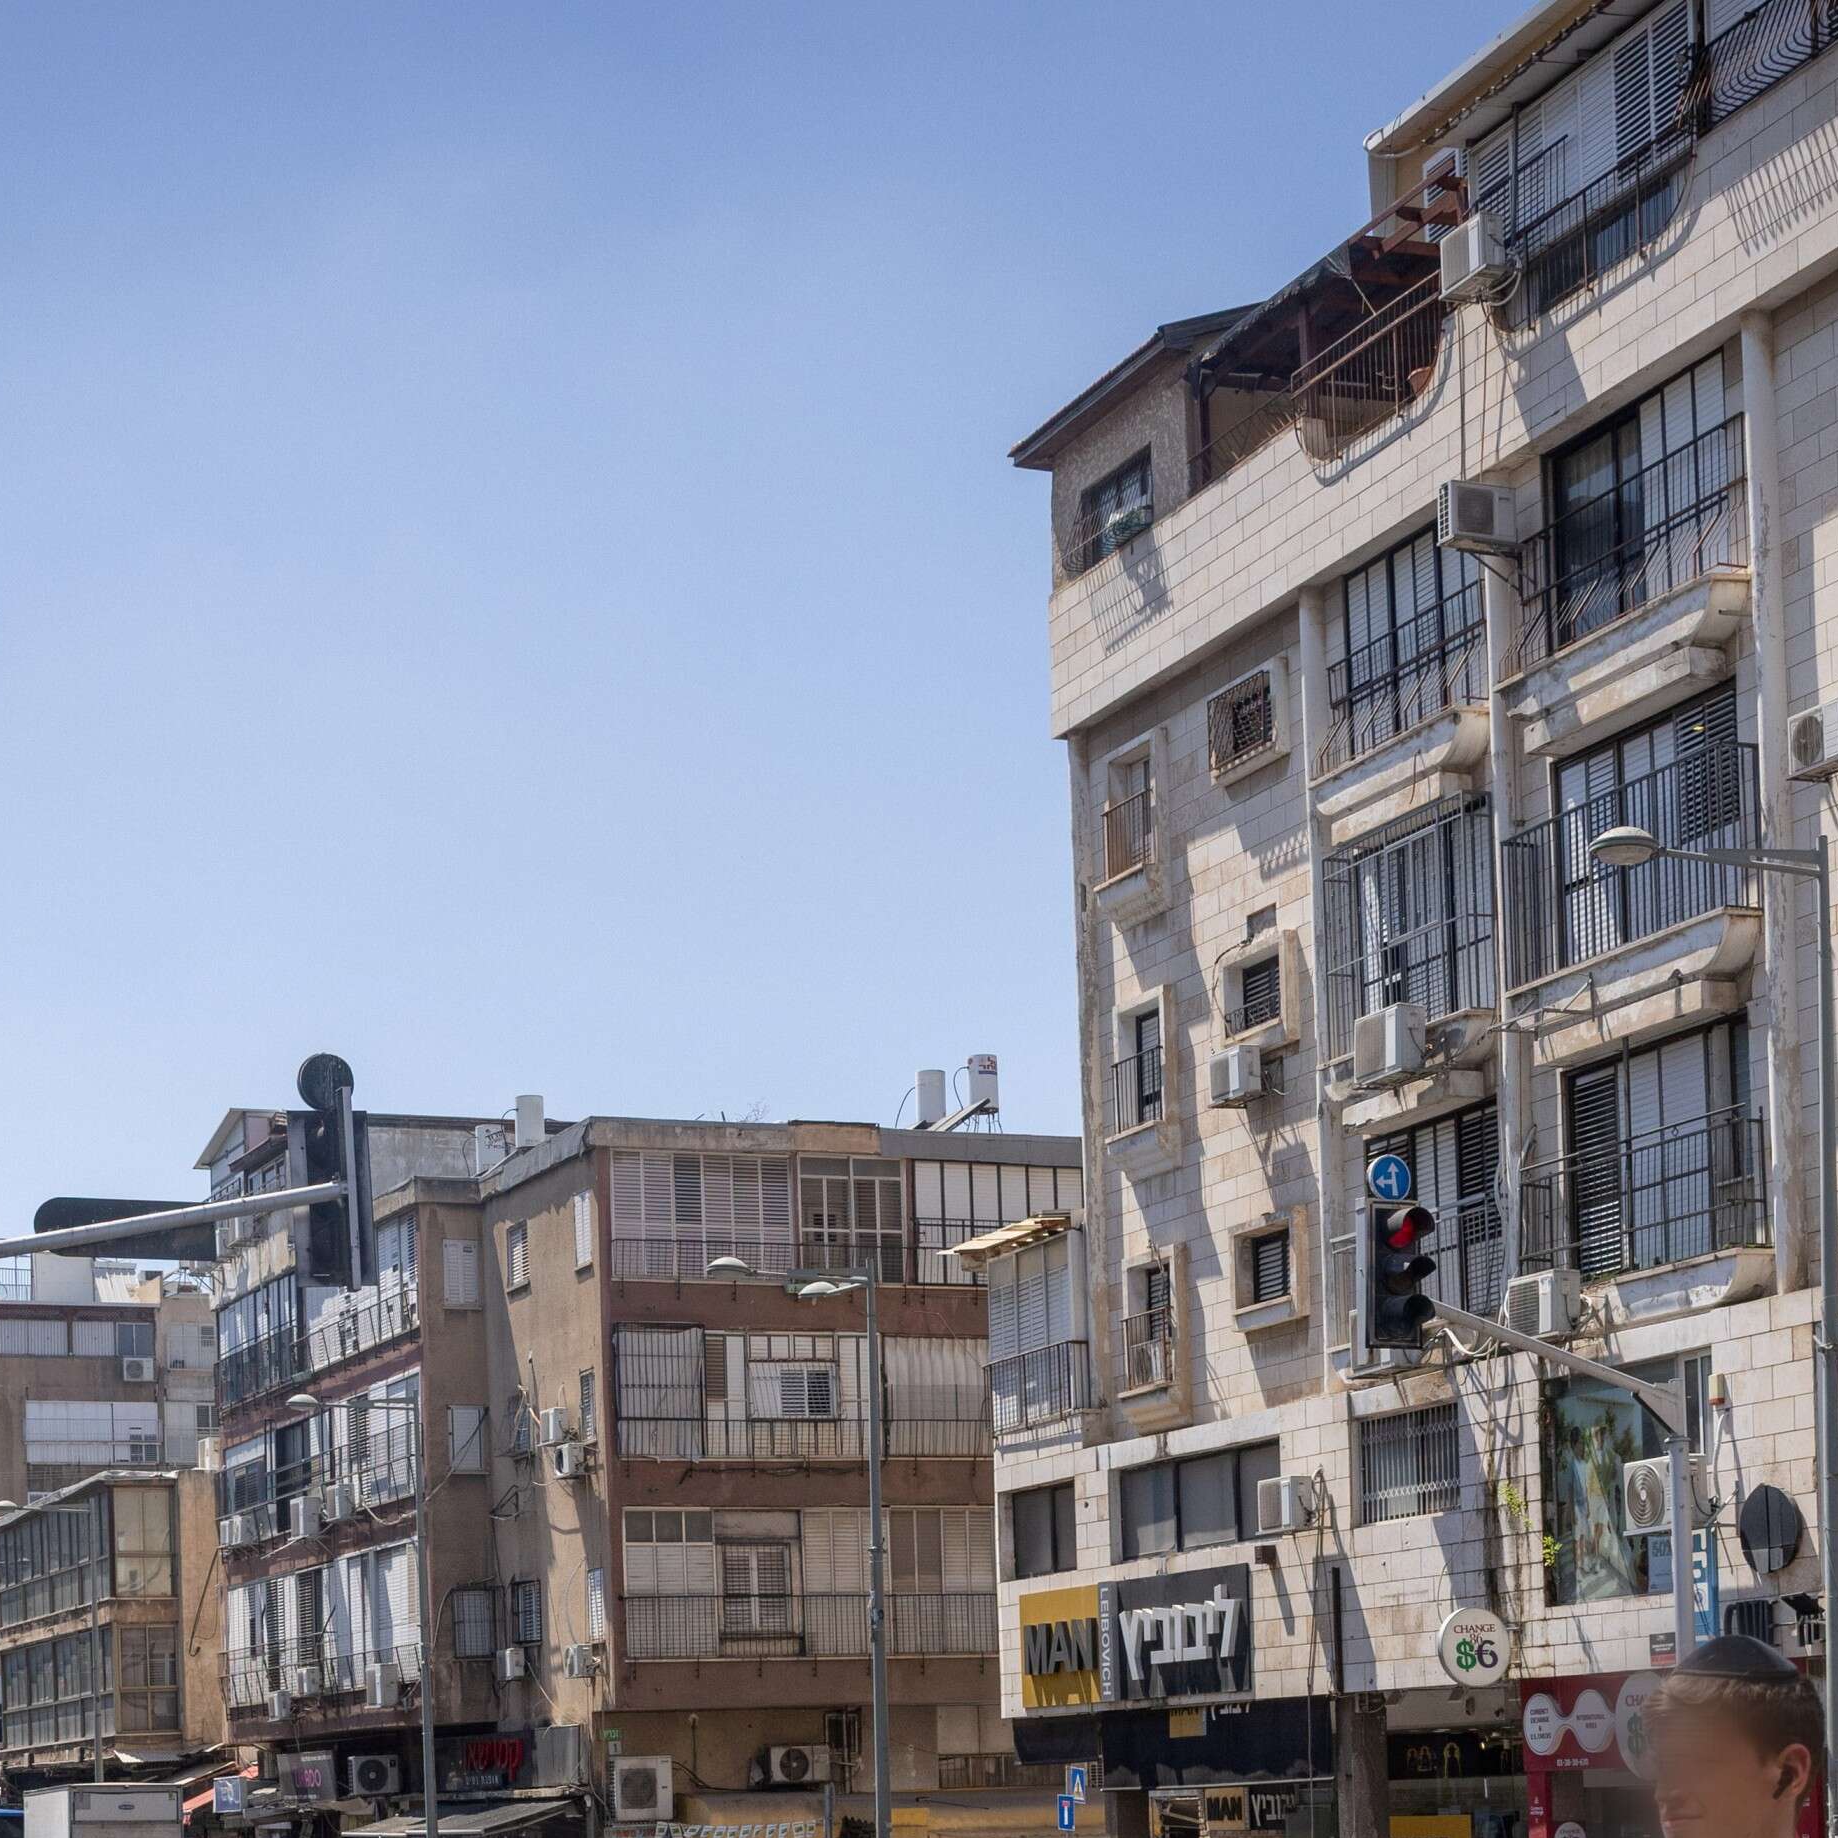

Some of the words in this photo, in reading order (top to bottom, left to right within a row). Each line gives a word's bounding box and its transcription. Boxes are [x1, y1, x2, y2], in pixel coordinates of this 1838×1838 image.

[1023, 1616, 1099, 1677] MAN
[1099, 1586, 1113, 1698] LEIBOVICH
[1118, 1583, 1243, 1681] ליבוביץ
[1453, 1623, 1497, 1634] CHANGE
[1206, 1796, 1243, 1822] MAN
